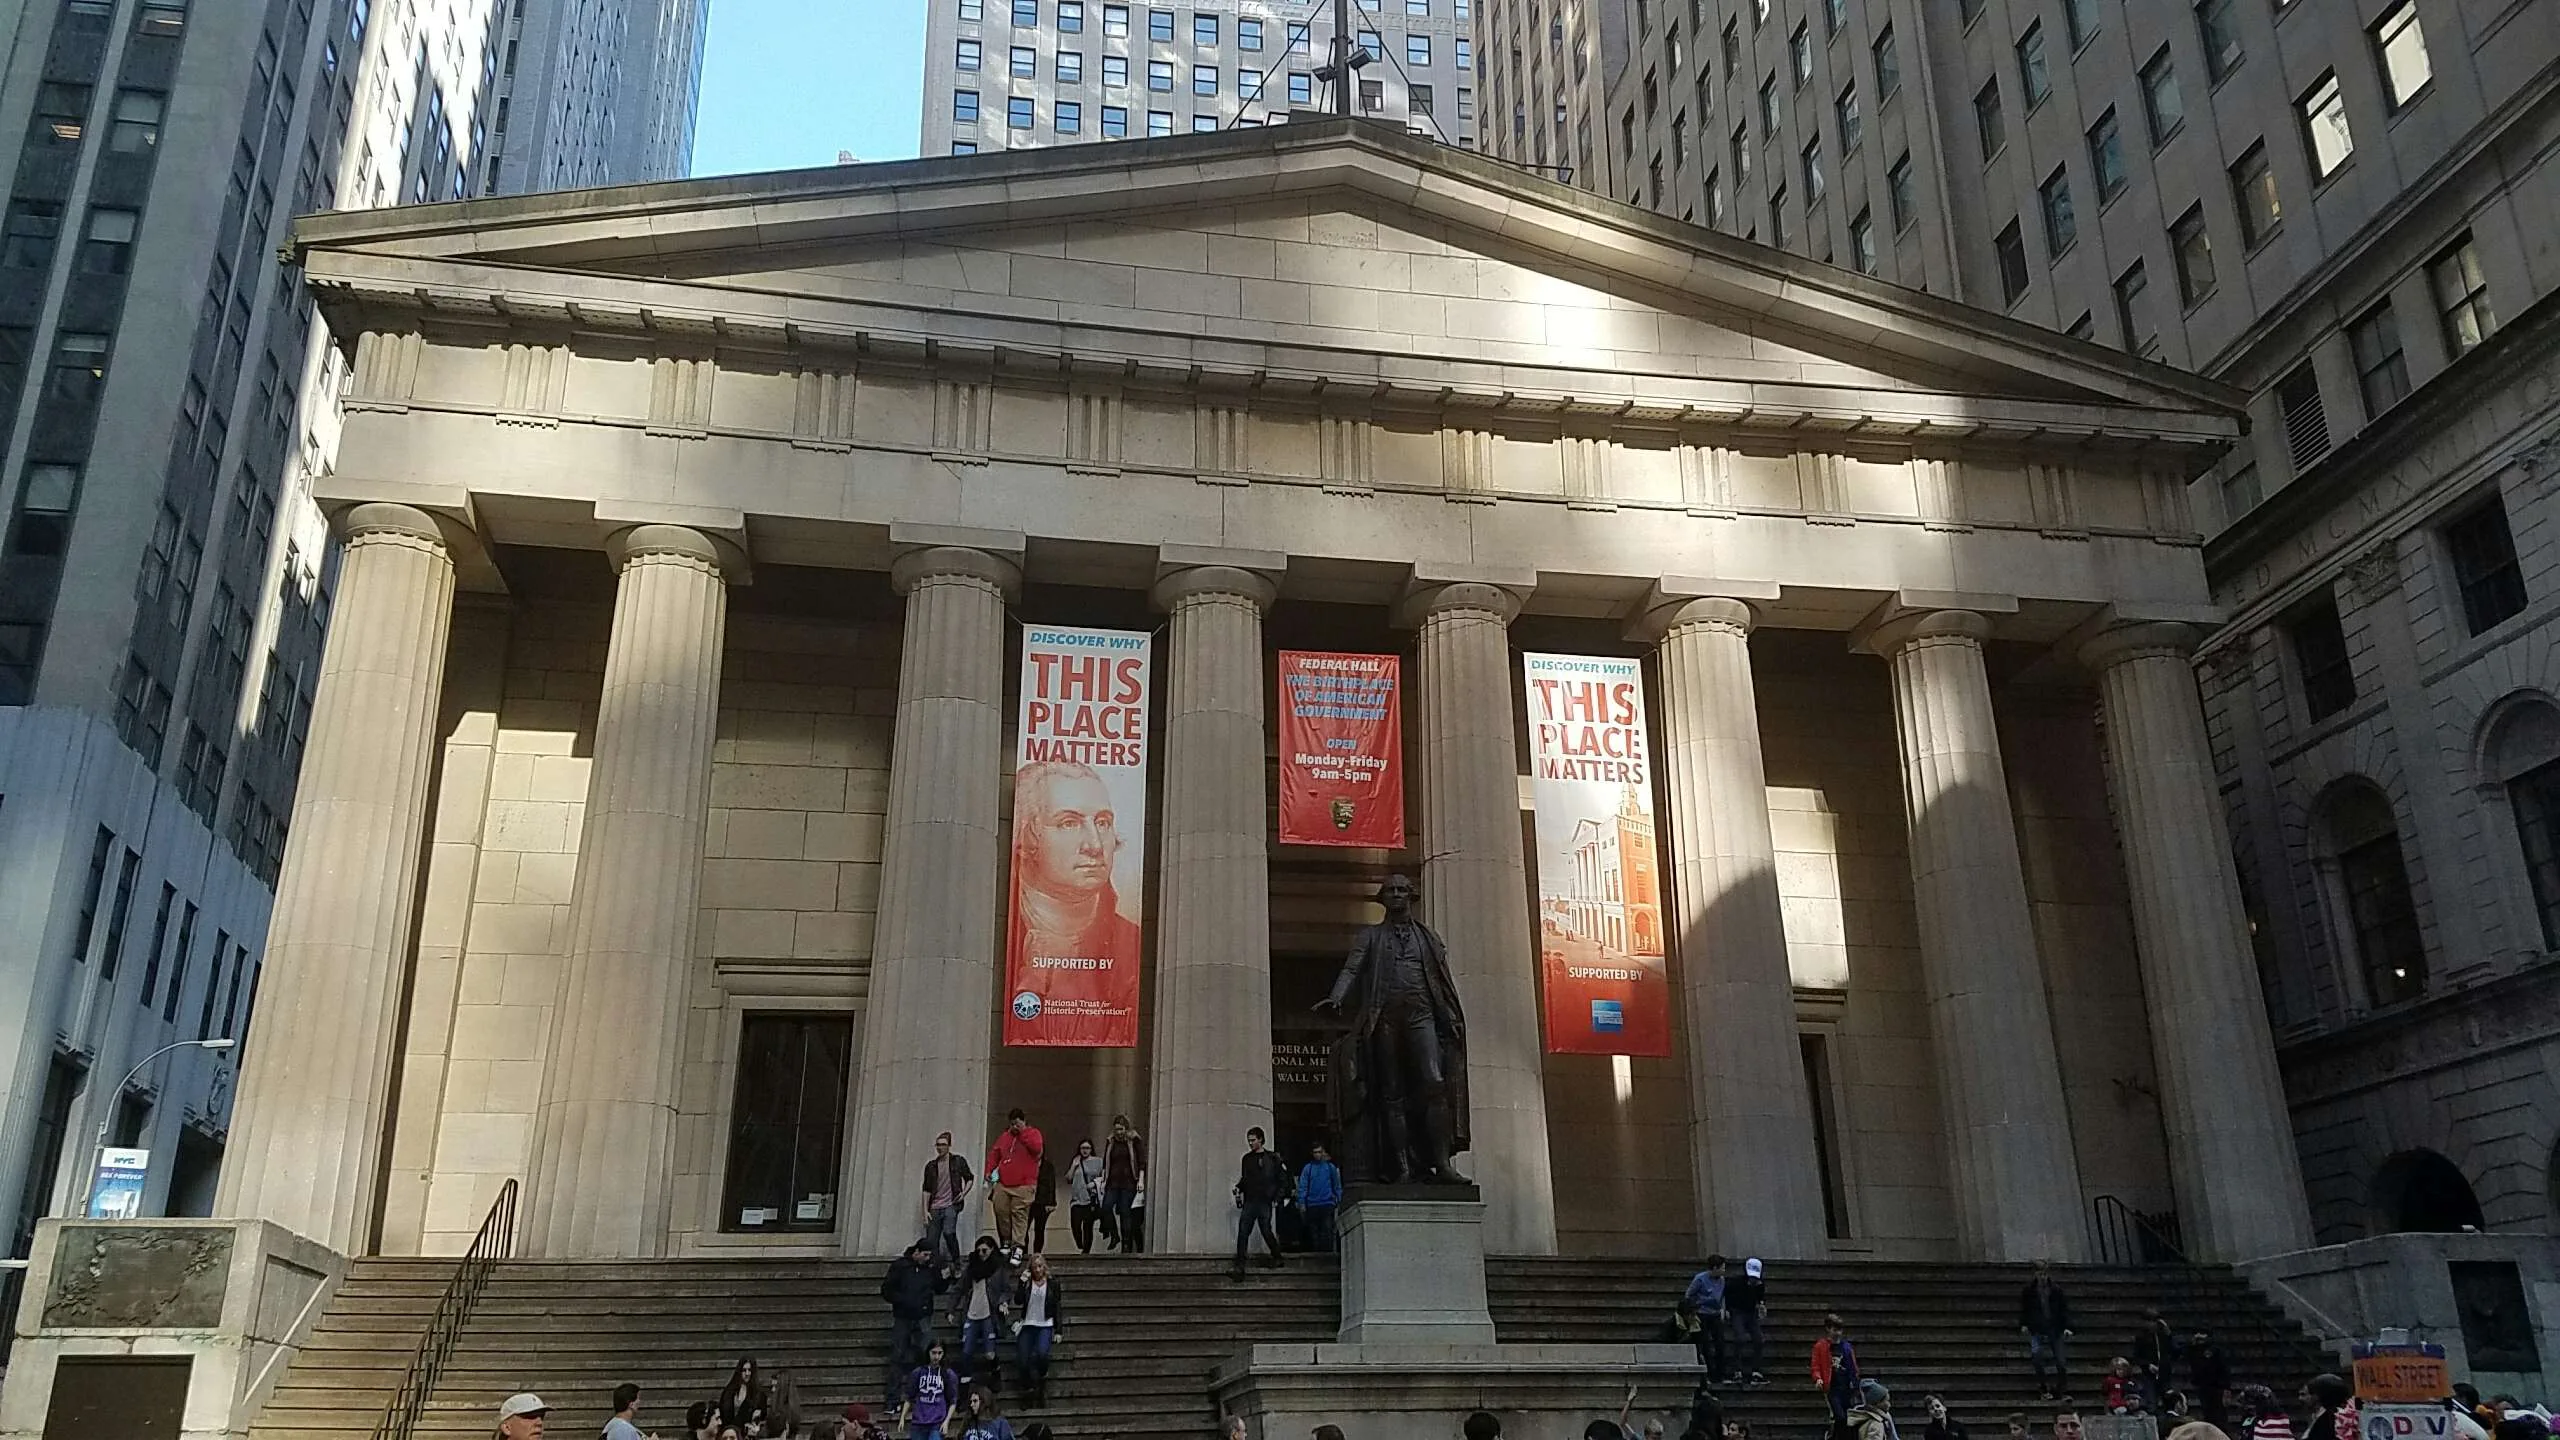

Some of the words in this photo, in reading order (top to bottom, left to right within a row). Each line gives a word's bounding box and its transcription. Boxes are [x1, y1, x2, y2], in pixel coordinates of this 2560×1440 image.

[1030, 632, 1105, 648] DISCOVER
[1109, 637, 1145, 650] WHY
[1299, 658, 1349, 671] FEDERAL
[1350, 660, 1380, 672] HALL
[1531, 660, 1600, 673] DISCOVER
[1603, 664, 1636, 675] WHY
[1030, 653, 1144, 705] THIS
[1286, 674, 1310, 687] THE
[1312, 675, 1394, 691] BIRTHPLACE
[1295, 689, 1312, 702] OF
[1315, 691, 1386, 705] AMERICAN
[1532, 679, 1638, 726] THIS
[1028, 701, 1142, 740] PLACE
[1294, 705, 1388, 721] GOVERNMENT
[1327, 738, 1357, 750] OPEN
[1537, 722, 1642, 760] PLACE
[1025, 738, 1142, 767] MATTERS
[1295, 753, 1388, 771] Monday-Friday
[1312, 768, 1372, 784] 9am-5pm
[1538, 758, 1644, 785] MATTERS
[1032, 957, 1096, 970] SUPPORTED
[1099, 958, 1114, 970] BY
[1568, 966, 1628, 980] SUPPORTED
[1630, 970, 1644, 981] BY
[1044, 999, 1078, 1007] National
[1080, 999, 1100, 1008] Trust
[1044, 1007, 1076, 1015] Historic
[1277, 1072, 1309, 1082] WALL
[113, 1157, 136, 1165] NYC
[2356, 1365, 2393, 1388] WALL
[2394, 1364, 2441, 1389] STREET
